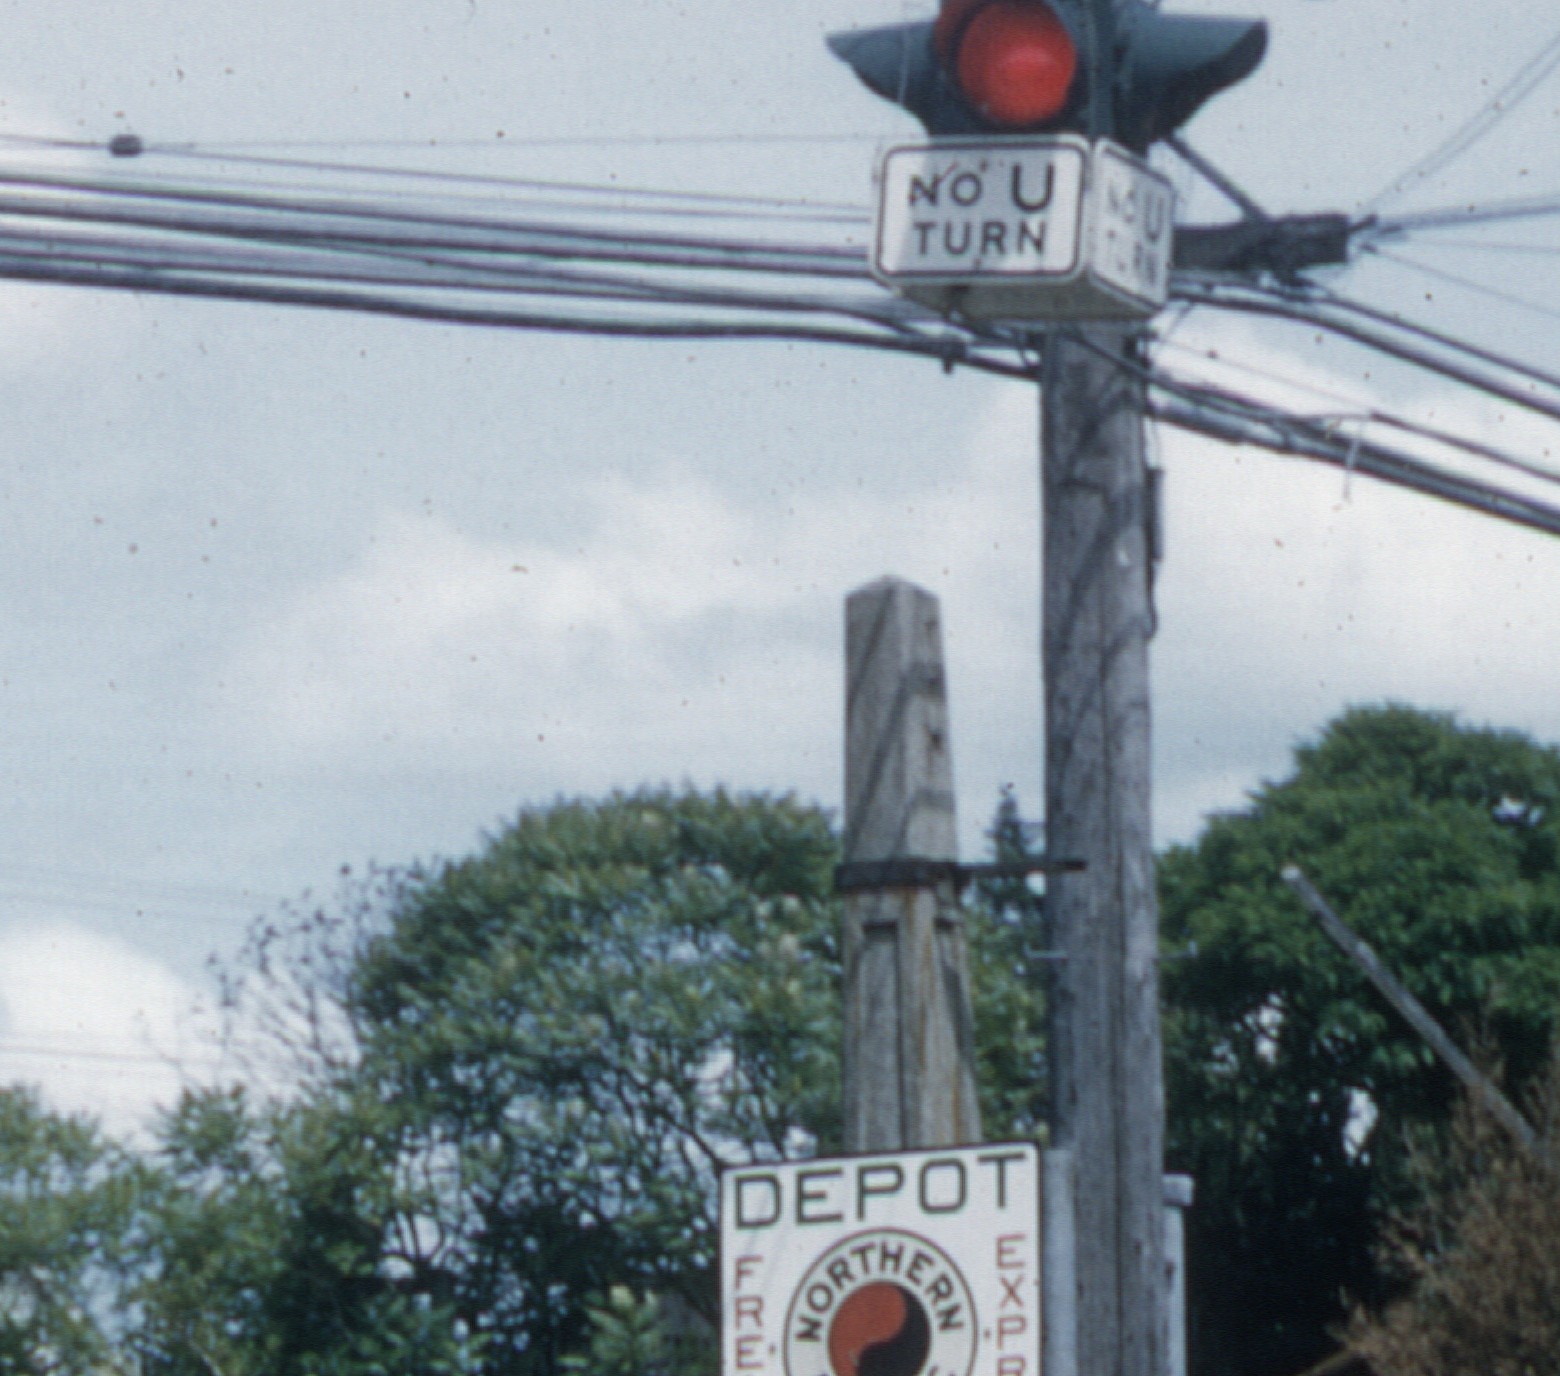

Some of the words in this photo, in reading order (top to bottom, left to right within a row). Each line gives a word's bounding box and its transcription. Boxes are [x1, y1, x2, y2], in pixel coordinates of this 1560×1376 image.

[908, 171, 980, 207] NO
[1011, 162, 1054, 212] U
[913, 220, 1046, 256] TURN
[734, 1151, 1026, 1230] DEPOT
[794, 1240, 964, 1343] NORTHERN
